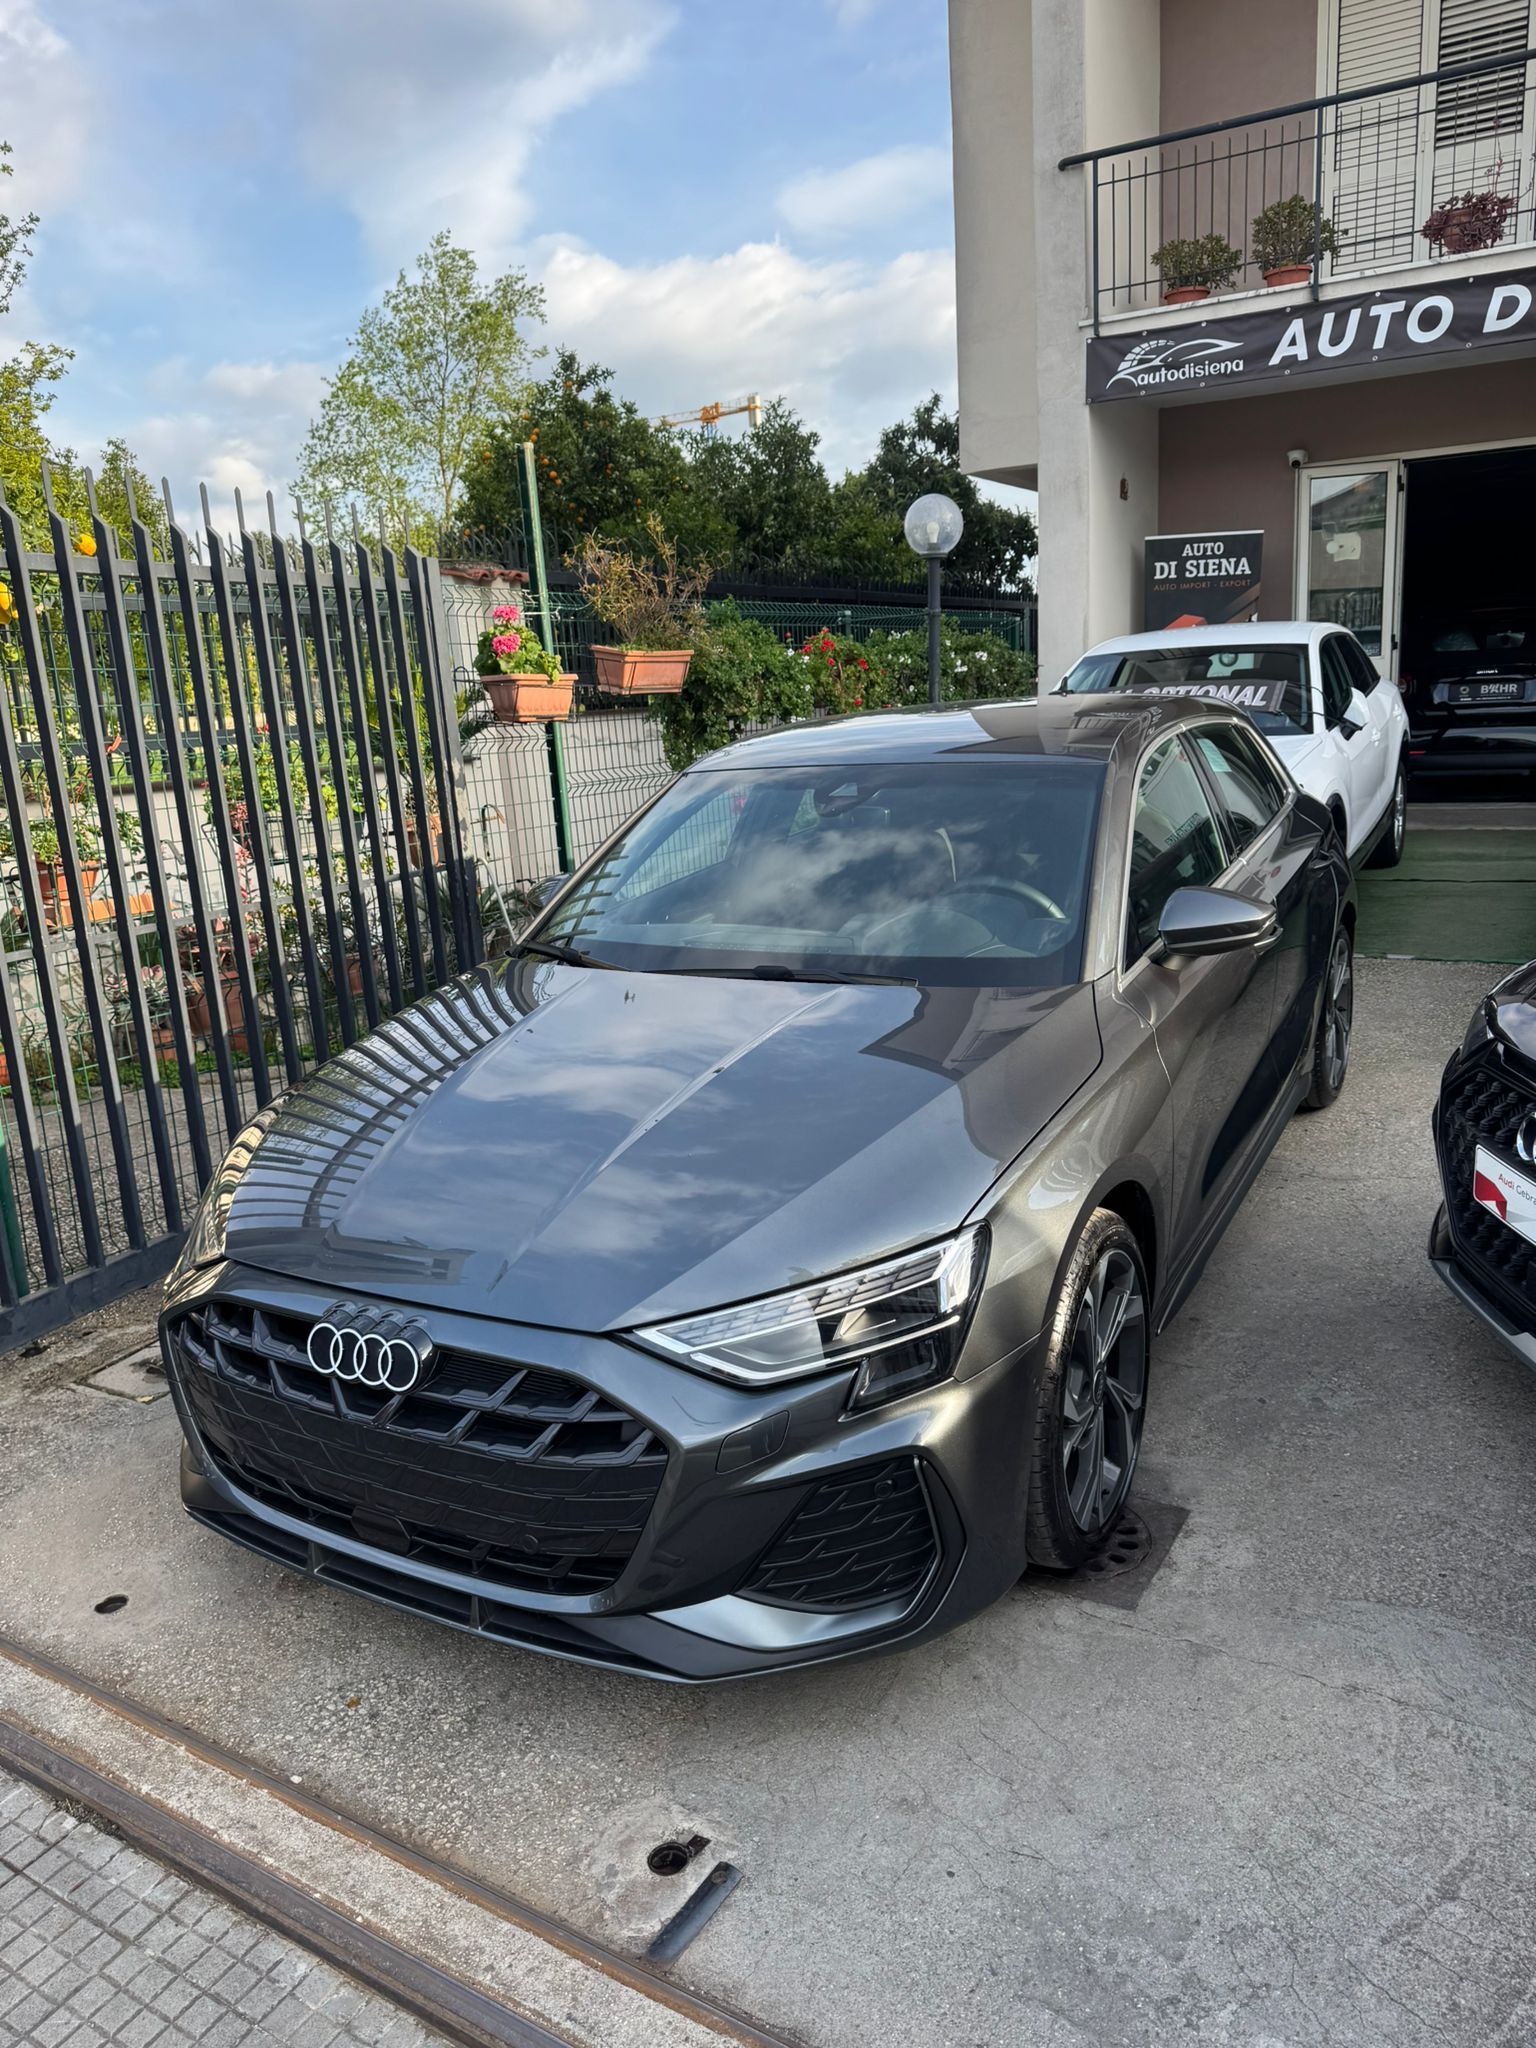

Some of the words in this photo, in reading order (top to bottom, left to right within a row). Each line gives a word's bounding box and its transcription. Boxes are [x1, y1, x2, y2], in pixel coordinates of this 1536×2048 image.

[1268, 295, 1454, 366] AUTO
[1137, 359, 1244, 385] autodisiena
[1182, 542, 1224, 557] AUTO
[1154, 561, 1178, 579] DI
[1185, 557, 1251, 578] SIENA
[1153, 583, 1177, 591] AUTO
[1220, 580, 1251, 588] EXPORT
[1498, 1173, 1515, 1190] Audi
